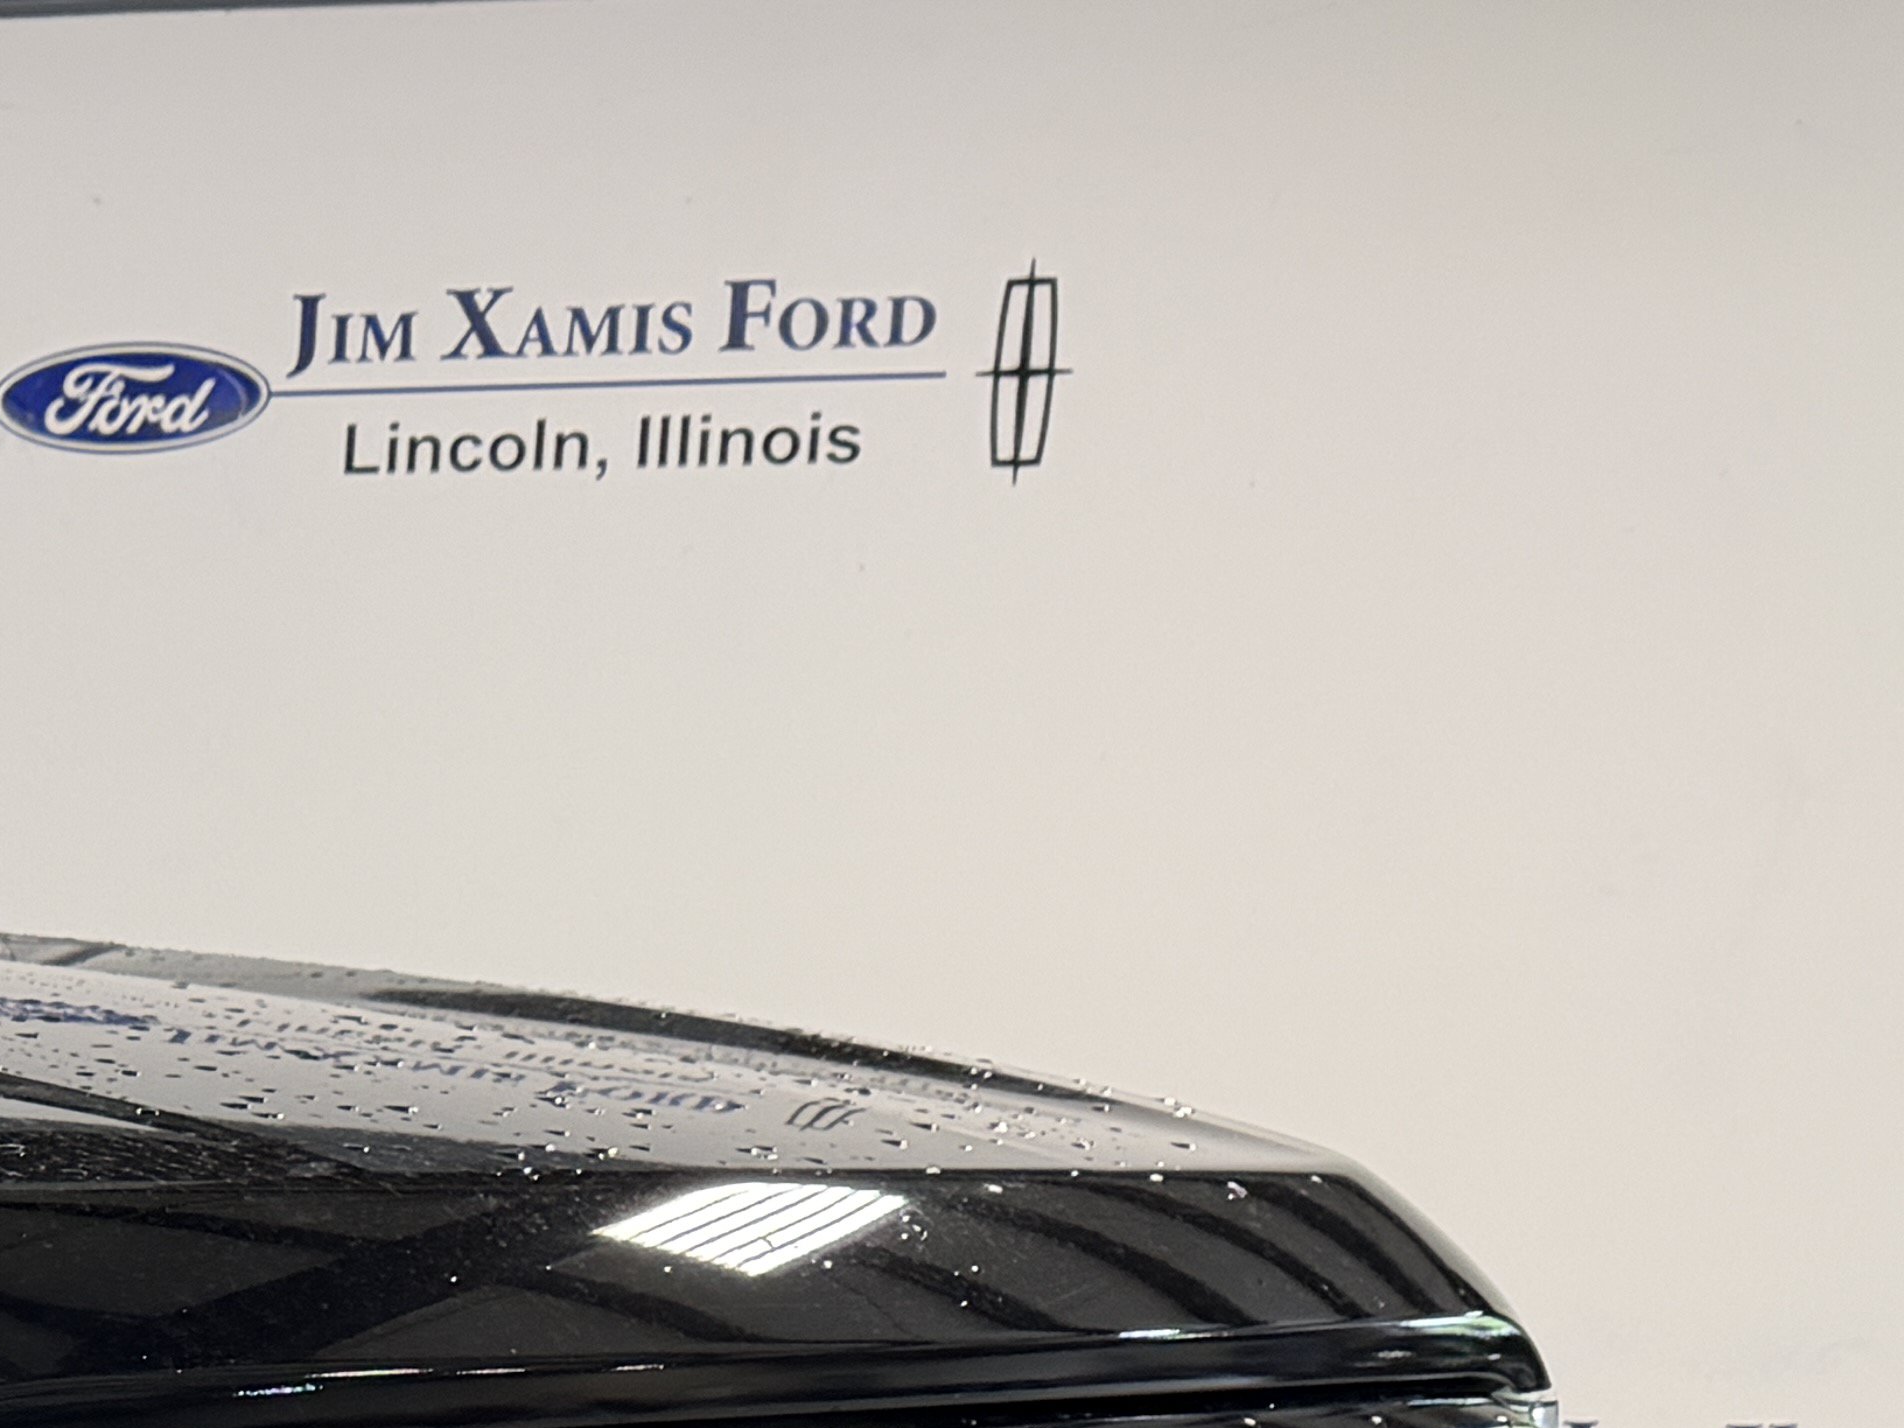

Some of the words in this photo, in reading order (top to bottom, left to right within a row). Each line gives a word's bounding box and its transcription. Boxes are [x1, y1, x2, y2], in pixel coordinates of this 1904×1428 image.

[286, 292, 416, 379] JIM
[441, 284, 695, 363] XAMIS
[718, 276, 937, 353] FORD
[43, 364, 215, 437] Ford
[342, 416, 609, 480] Lincoln,
[635, 411, 864, 470] Illinois
